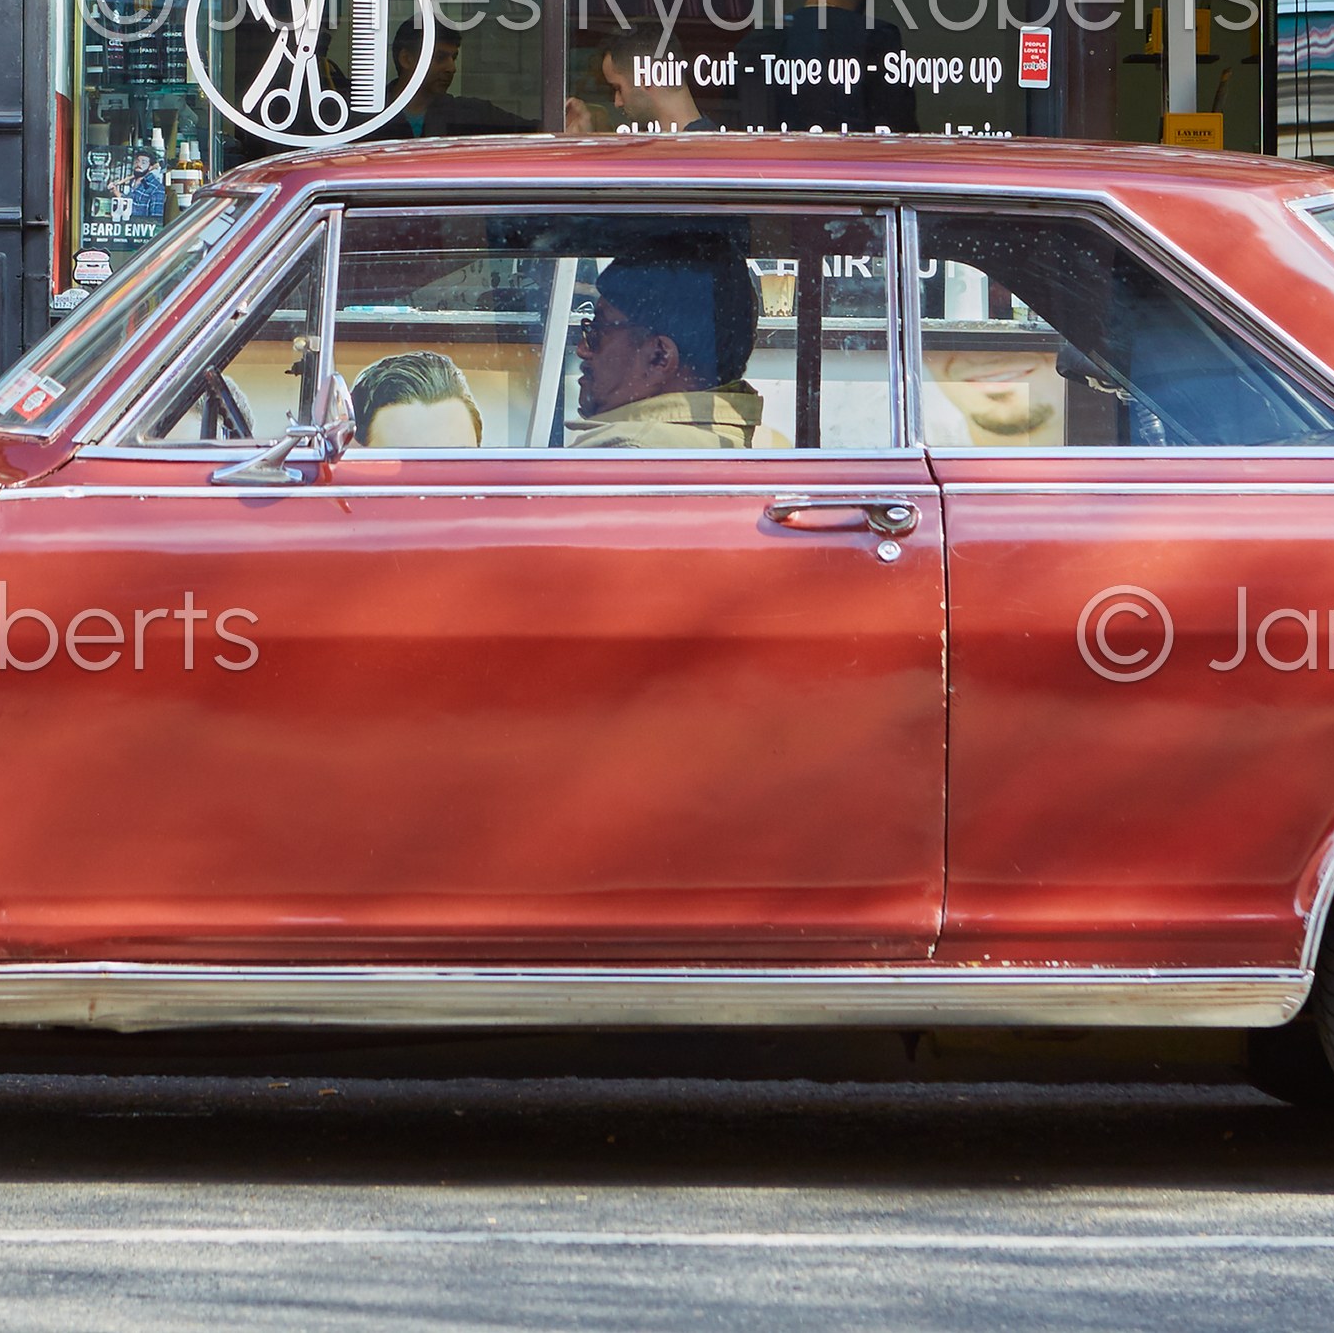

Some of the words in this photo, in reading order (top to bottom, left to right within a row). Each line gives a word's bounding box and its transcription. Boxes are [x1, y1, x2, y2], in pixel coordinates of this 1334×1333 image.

[633, 55, 688, 87] Hair
[693, 51, 739, 87] Cut
[760, 51, 823, 95] Tape
[827, 58, 861, 95] up
[883, 51, 963, 95] Shape
[969, 57, 1004, 95] up
[83, 222, 122, 237] BEARD
